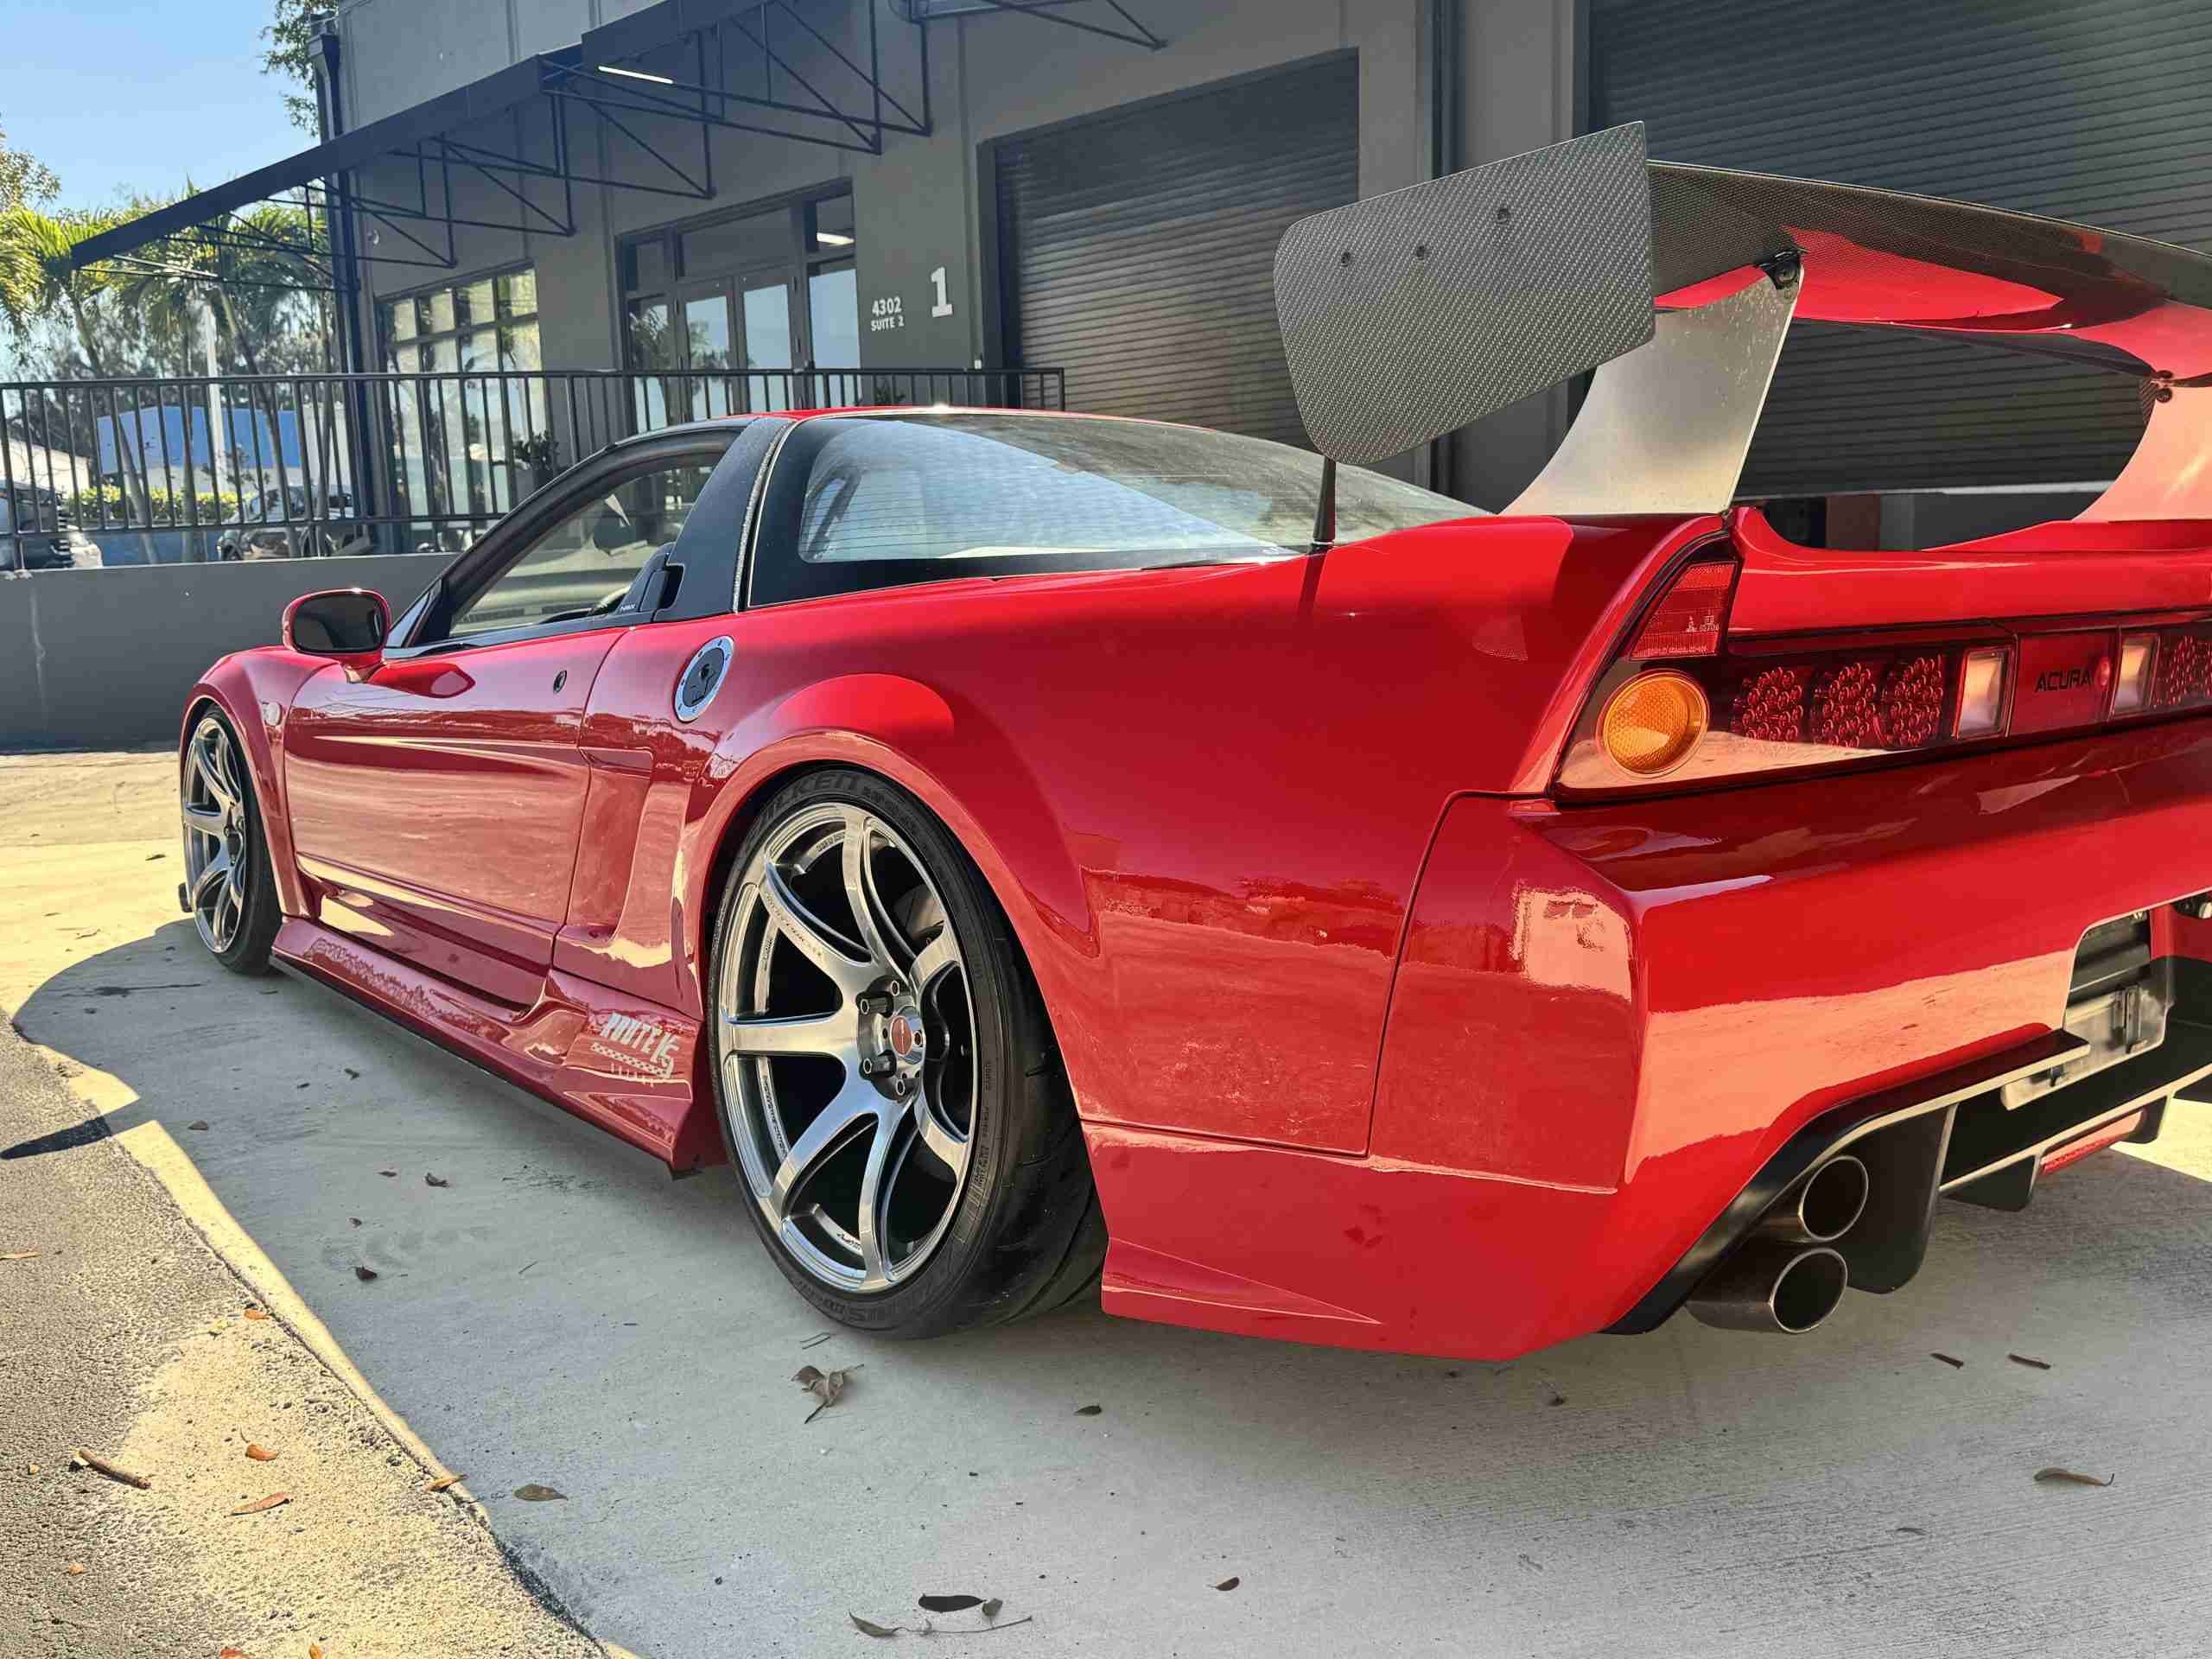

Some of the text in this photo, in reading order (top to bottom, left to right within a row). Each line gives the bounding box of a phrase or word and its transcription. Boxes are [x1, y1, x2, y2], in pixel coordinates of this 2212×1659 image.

[931, 266, 953, 318] 1
[872, 296, 902, 316] 4302
[871, 315, 905, 332] SUITE 2
[2034, 668, 2093, 693] ACURA
